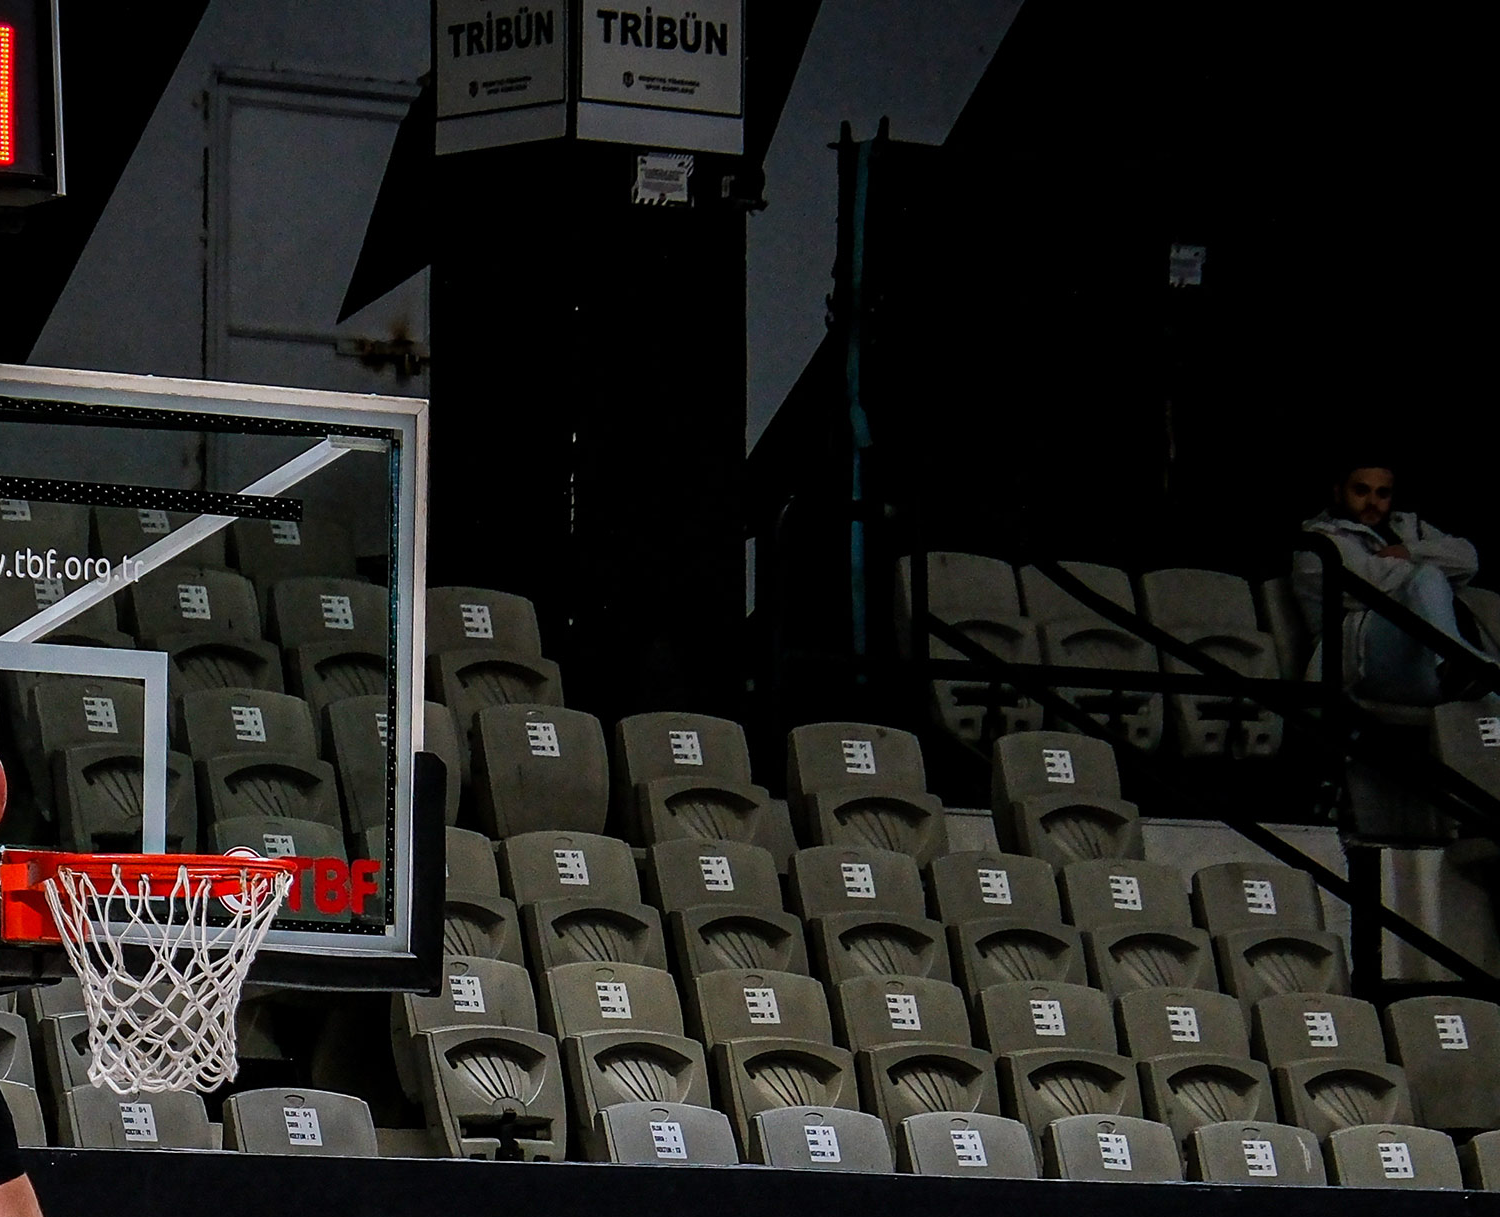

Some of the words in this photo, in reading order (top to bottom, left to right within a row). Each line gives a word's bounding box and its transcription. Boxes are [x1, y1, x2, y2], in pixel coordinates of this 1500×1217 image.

[448, 7, 554, 57] TRİBÜN
[596, 6, 729, 56] TRİBÜN
[280, 855, 381, 915] TBF
